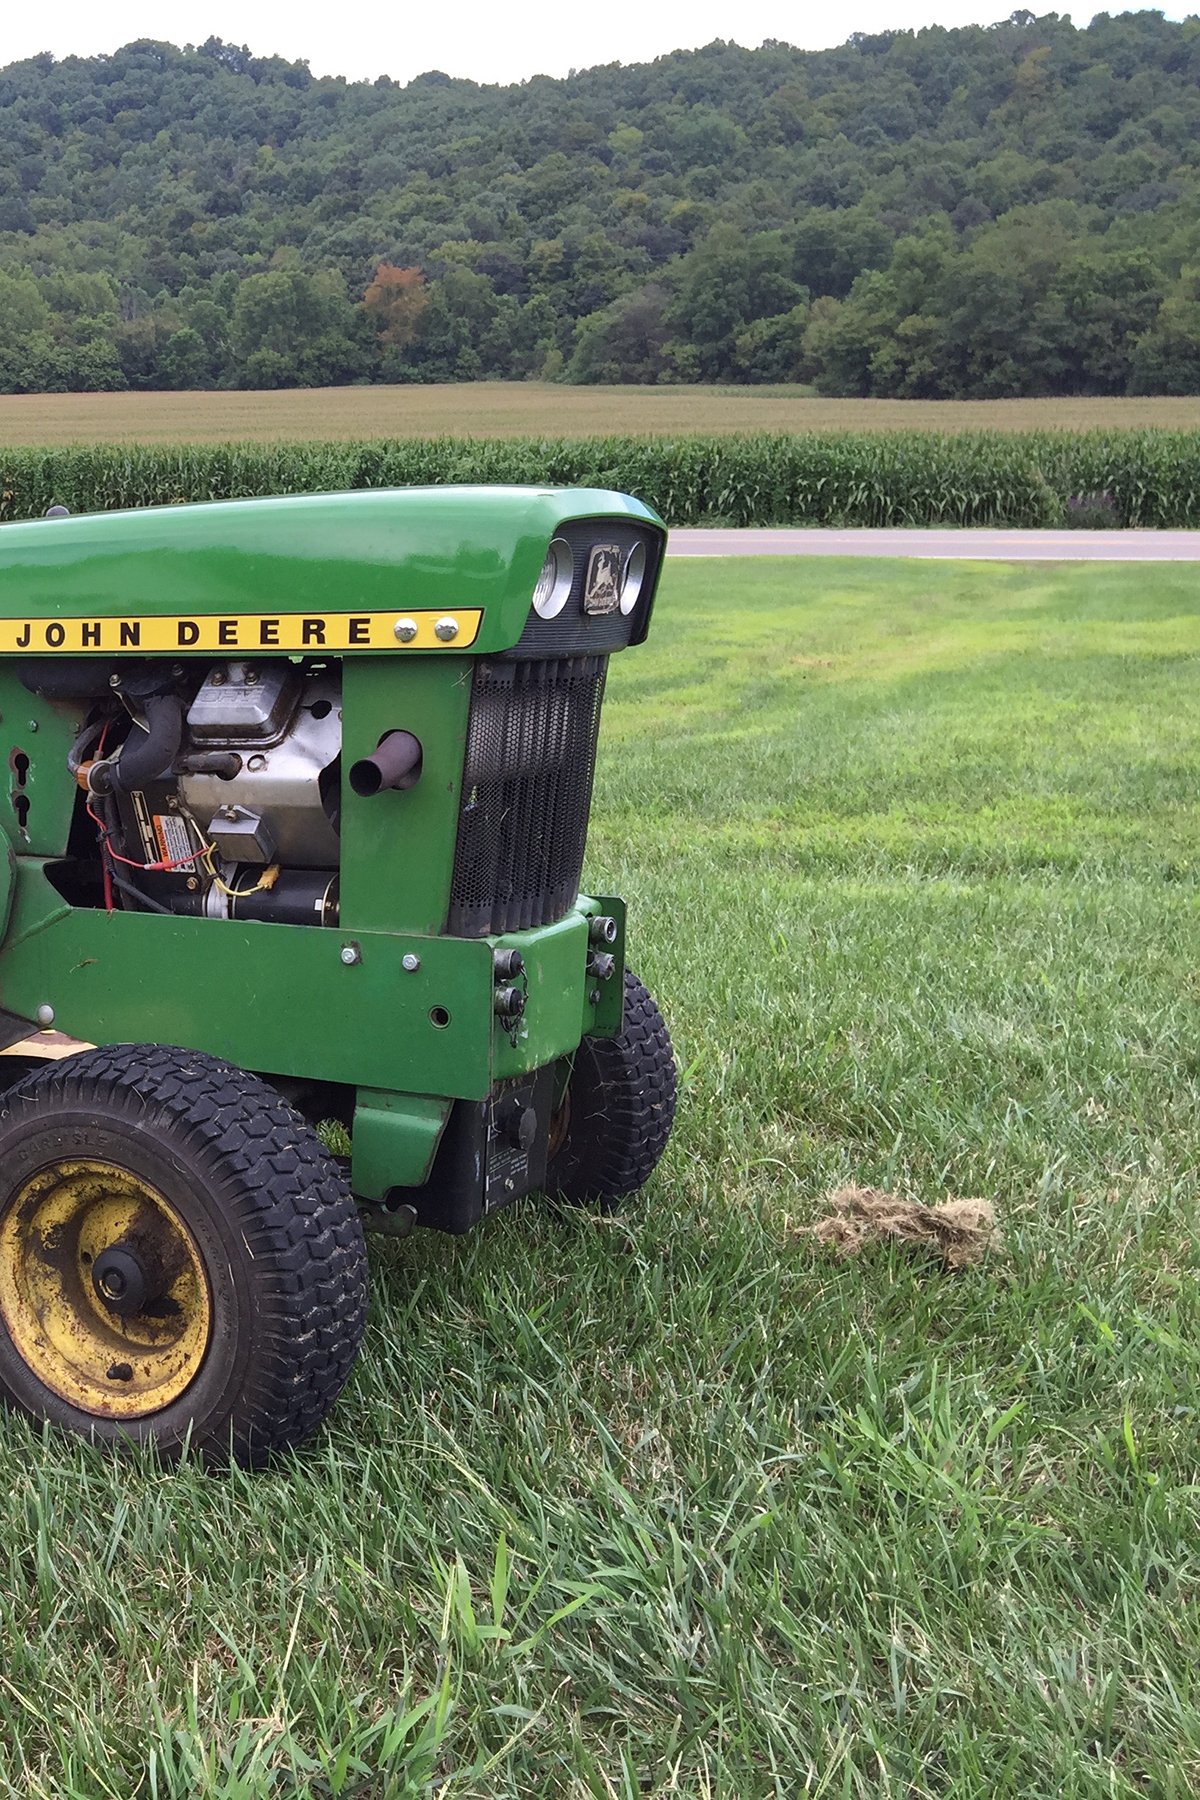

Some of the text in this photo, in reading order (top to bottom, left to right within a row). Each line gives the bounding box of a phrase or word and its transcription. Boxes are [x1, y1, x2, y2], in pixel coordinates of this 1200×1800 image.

[16, 622, 141, 648] JOHN
[177, 618, 372, 646] DEERE
[156, 825, 169, 857] WARNING
